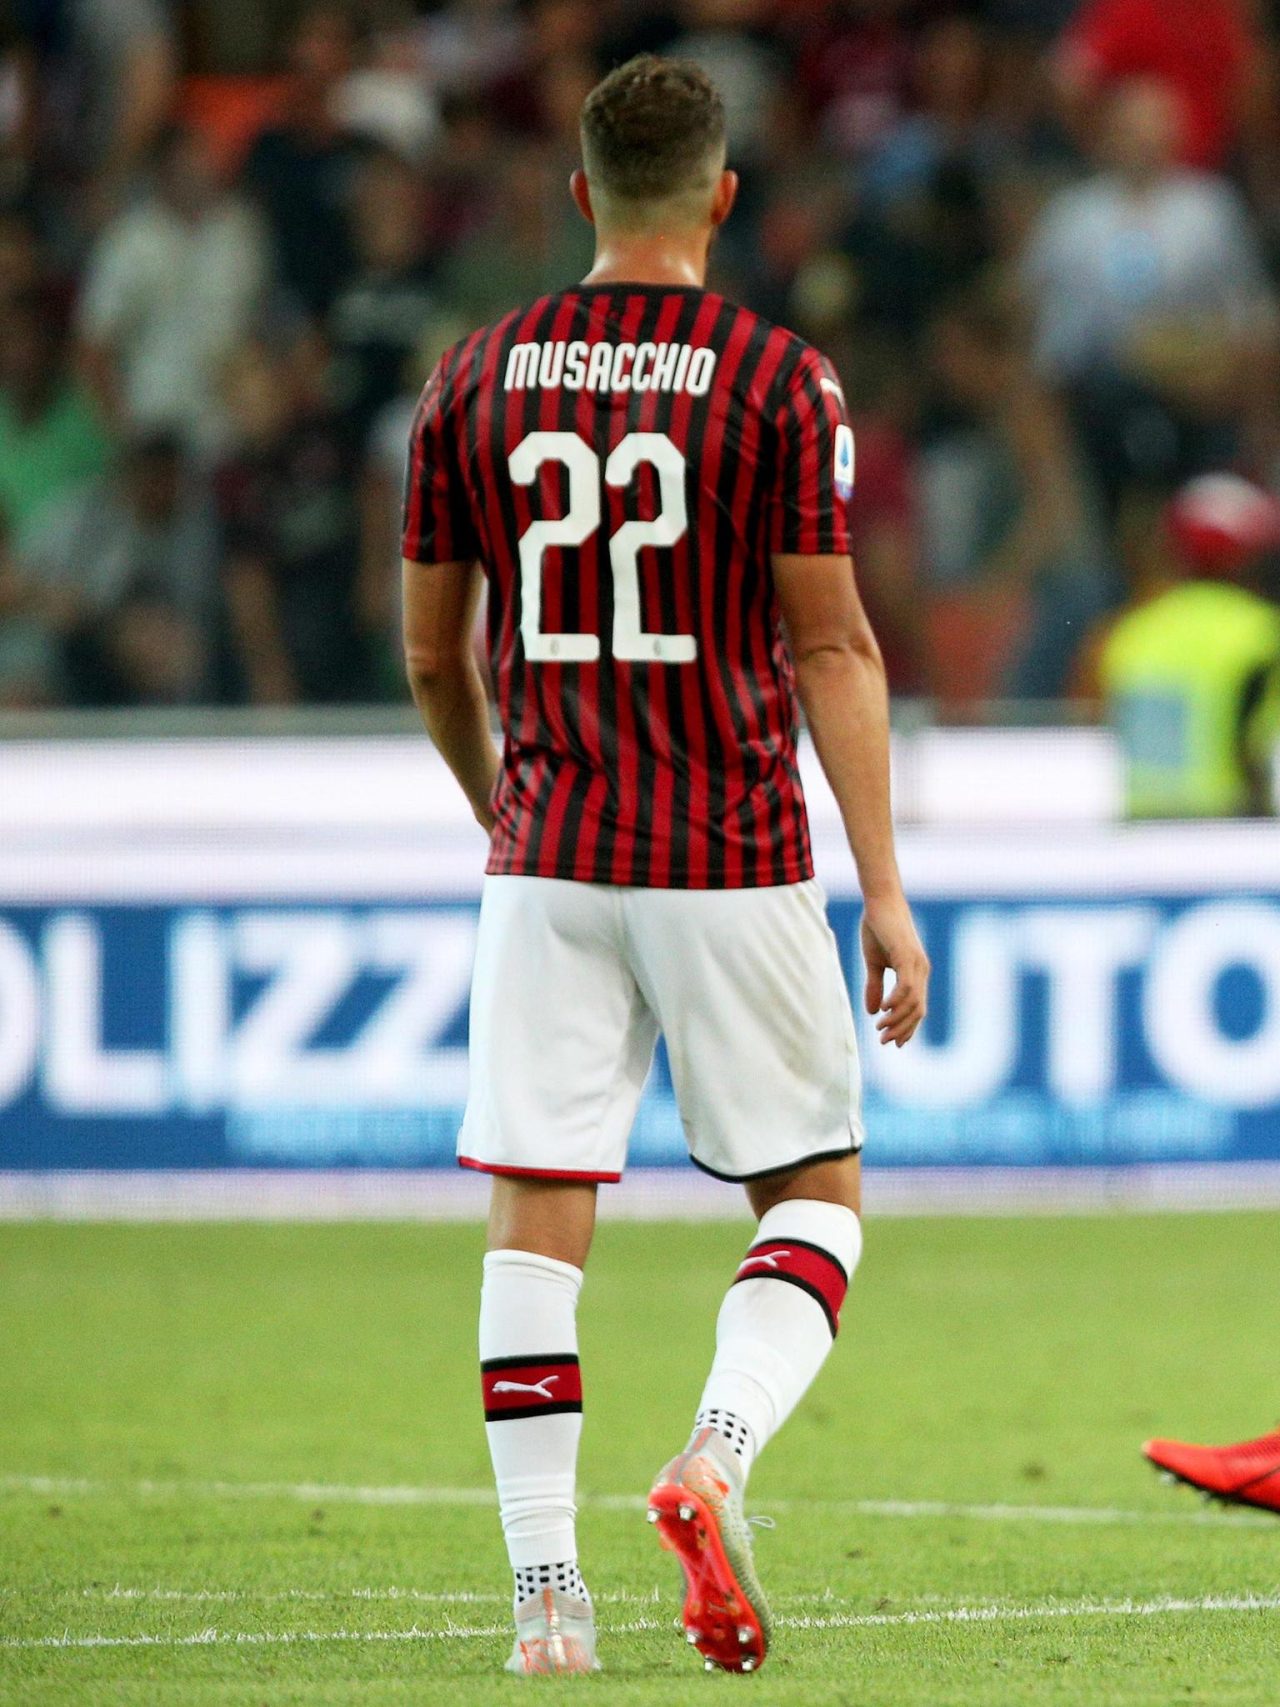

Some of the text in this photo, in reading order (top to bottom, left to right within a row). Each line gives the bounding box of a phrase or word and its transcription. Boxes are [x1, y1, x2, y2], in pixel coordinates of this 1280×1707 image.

[504, 341, 717, 397] MUSACCHIO
[507, 431, 698, 663] 22
[0, 908, 471, 1116] LIZZ
